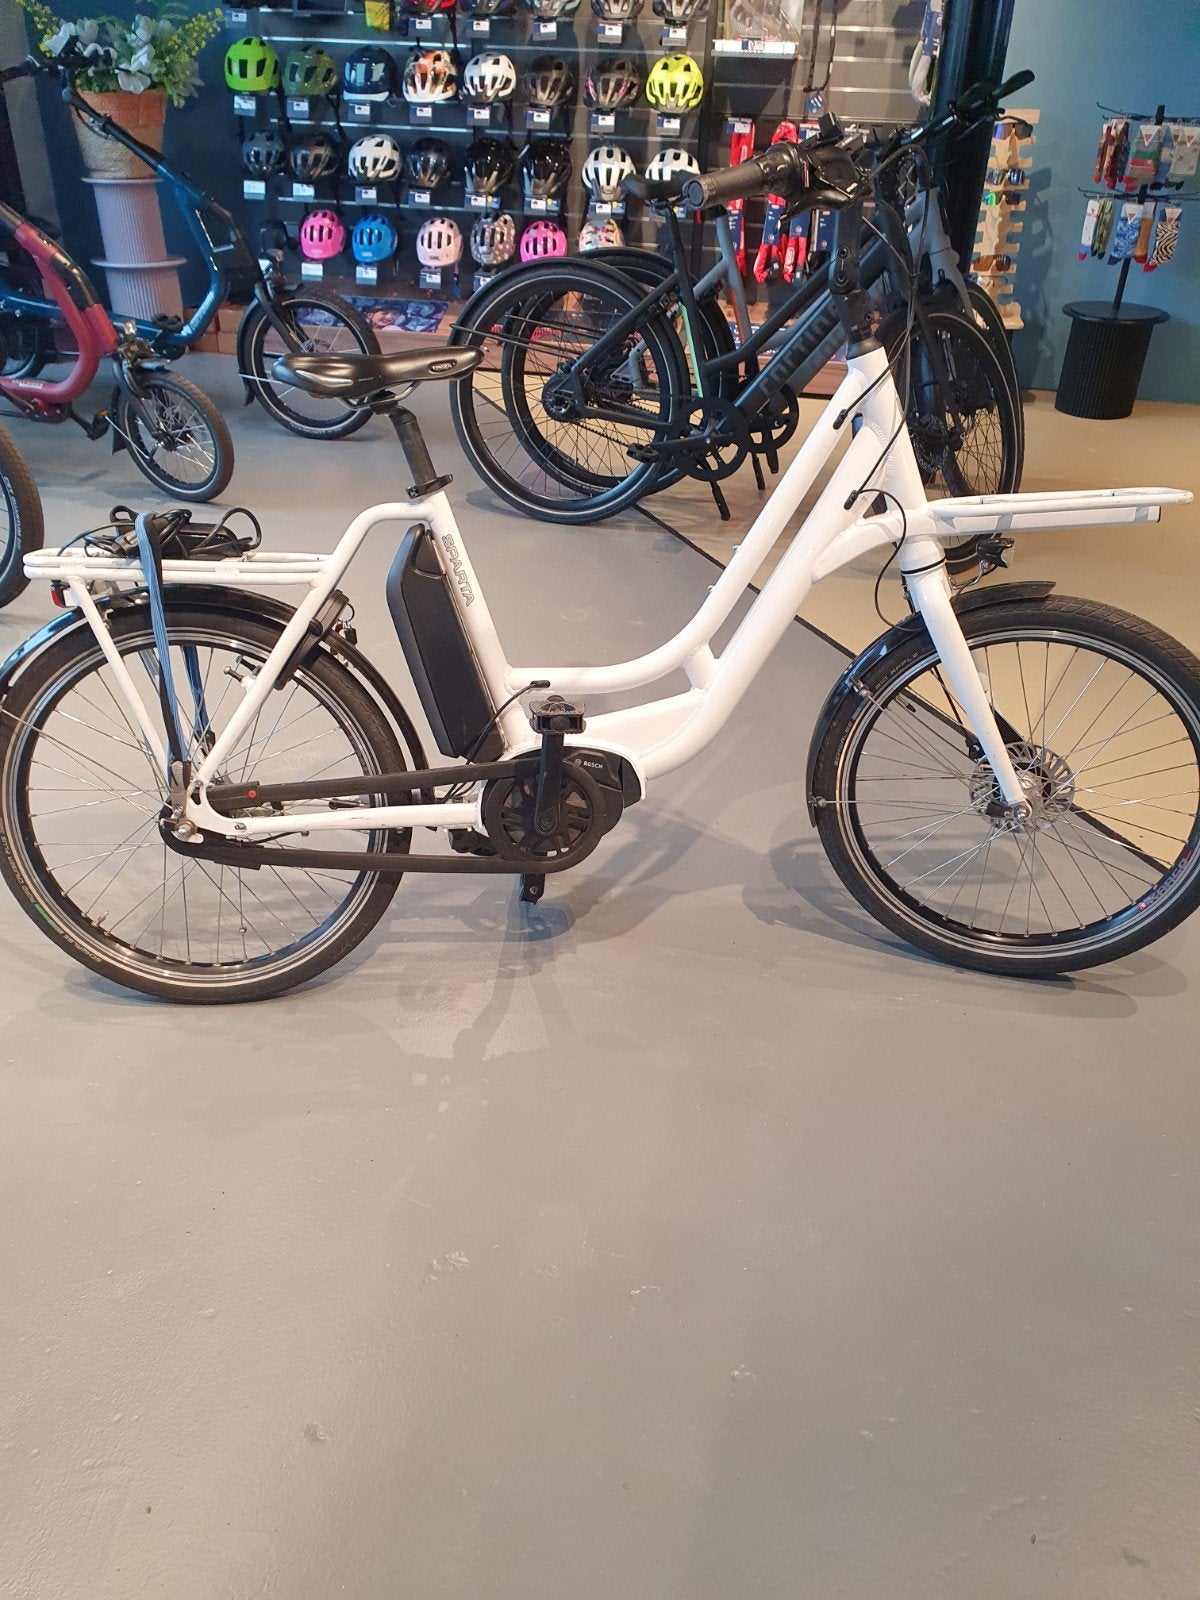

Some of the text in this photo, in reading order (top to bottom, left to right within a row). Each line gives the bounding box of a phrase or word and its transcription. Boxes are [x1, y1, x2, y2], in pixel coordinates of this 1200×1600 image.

[442, 534, 475, 607] SPARTA
[890, 652, 919, 675] APPLE
[834, 721, 853, 766] SCHWALBE
[583, 760, 603, 769] BOSCH
